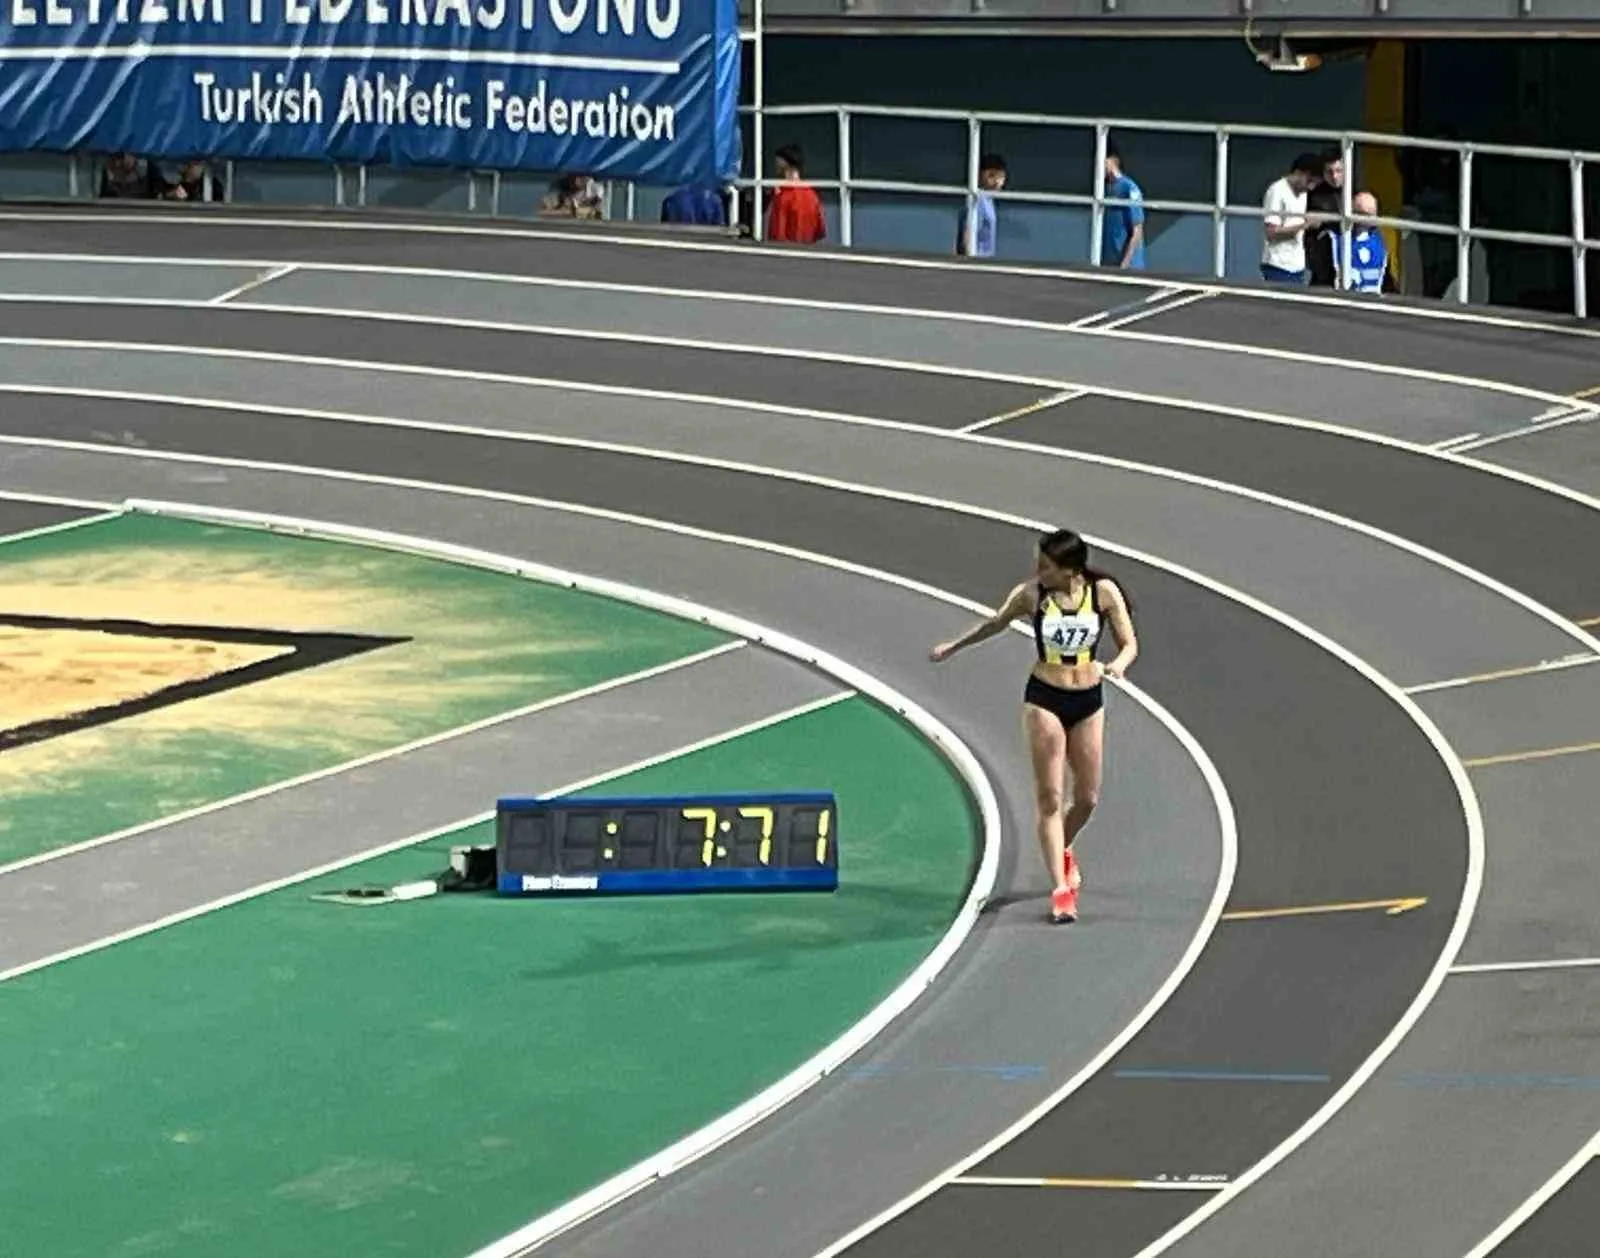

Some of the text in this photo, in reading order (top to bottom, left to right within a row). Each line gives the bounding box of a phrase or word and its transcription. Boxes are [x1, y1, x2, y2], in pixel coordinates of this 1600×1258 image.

[194, 73, 675, 141] Turkish Athletic Federation
[1052, 628, 1089, 645] 477
